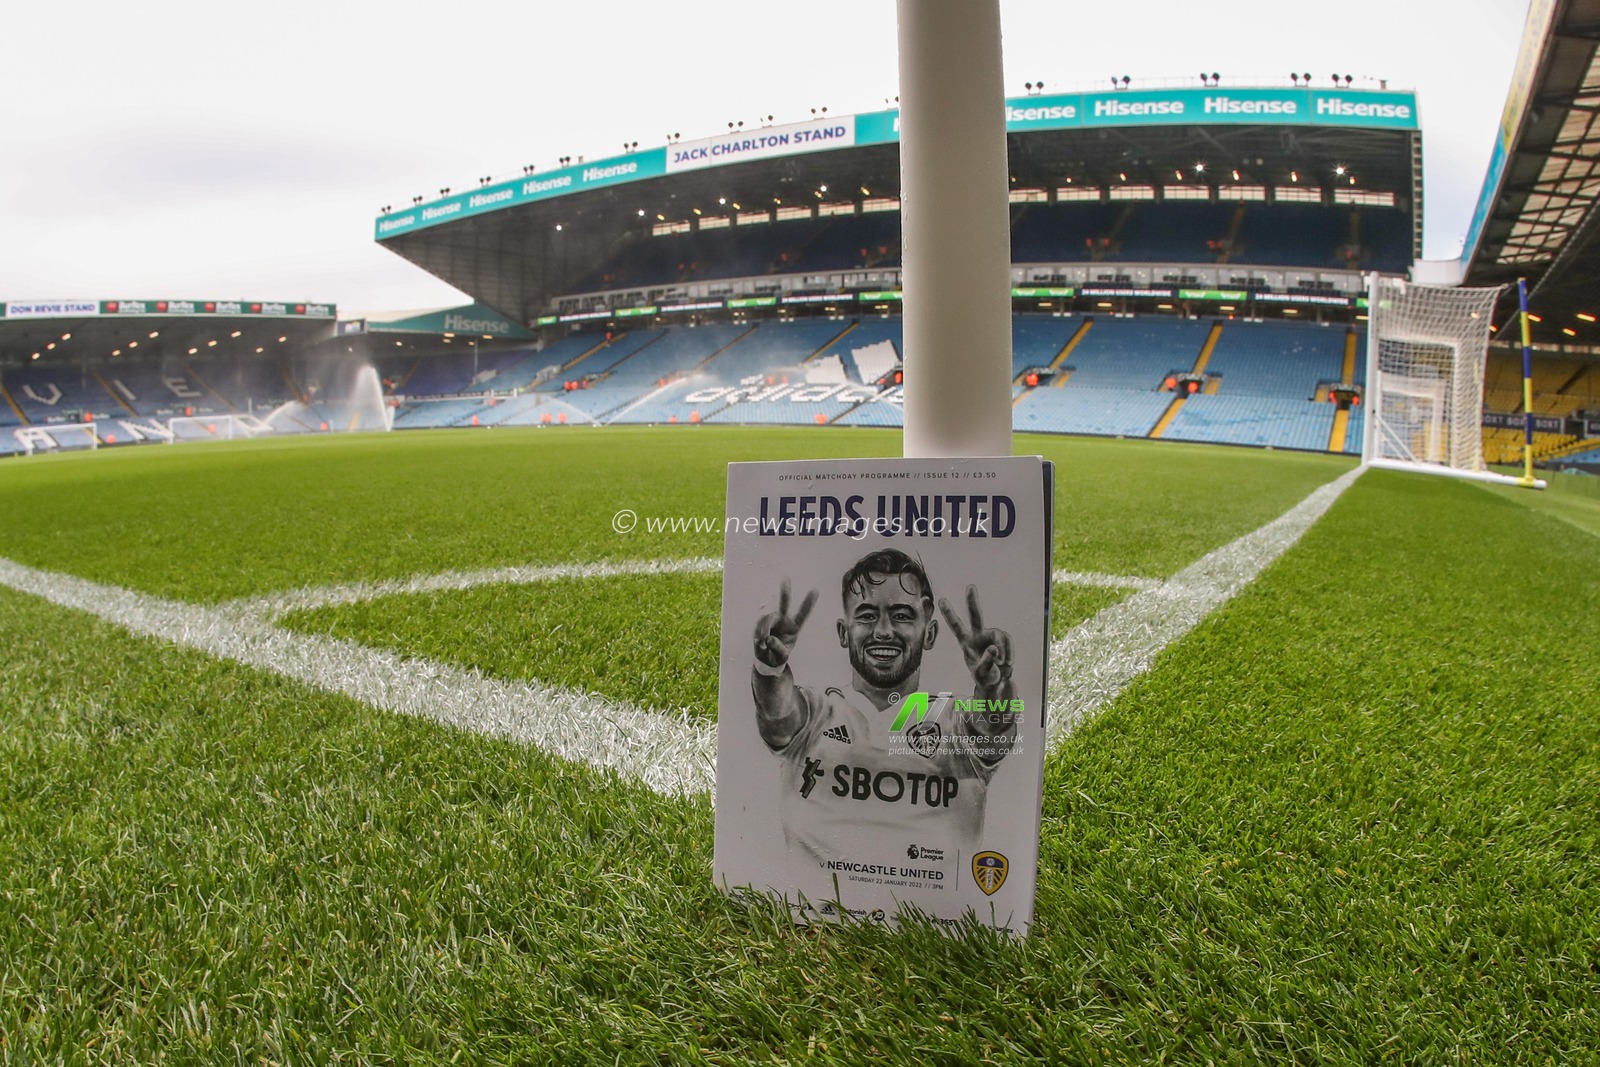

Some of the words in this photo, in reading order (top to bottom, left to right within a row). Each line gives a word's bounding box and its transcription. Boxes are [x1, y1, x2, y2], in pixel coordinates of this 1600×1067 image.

[1005, 105, 1076, 121] isense
[1094, 99, 1185, 117] Hisense
[1203, 96, 1297, 116] Hisense
[1316, 98, 1411, 119] Hisense
[674, 147, 708, 163] JACK
[712, 134, 789, 156] CHARLTON
[794, 126, 846, 144] STAND
[582, 161, 637, 182] Hisense
[522, 175, 572, 195] Hisense
[469, 188, 513, 208] Hisense
[422, 201, 461, 221] Hisense
[379, 214, 415, 233] Hisense
[11, 305, 31, 314] DON
[34, 304, 61, 313] REVIE
[64, 303, 95, 312] STAND
[444, 315, 510, 333] Hisense
[759, 496, 865, 537] LEEDS
[876, 495, 1016, 538] UNITED
[823, 731, 851, 744] adidas
[832, 764, 959, 808] SBOTOP
[920, 847, 944, 855] Premier
[920, 853, 944, 861] League
[827, 861, 897, 876] NEWCASTLE
[900, 868, 944, 880] UNITED
[848, 876, 875, 884] SATURDAY
[884, 879, 907, 887] JANUARY
